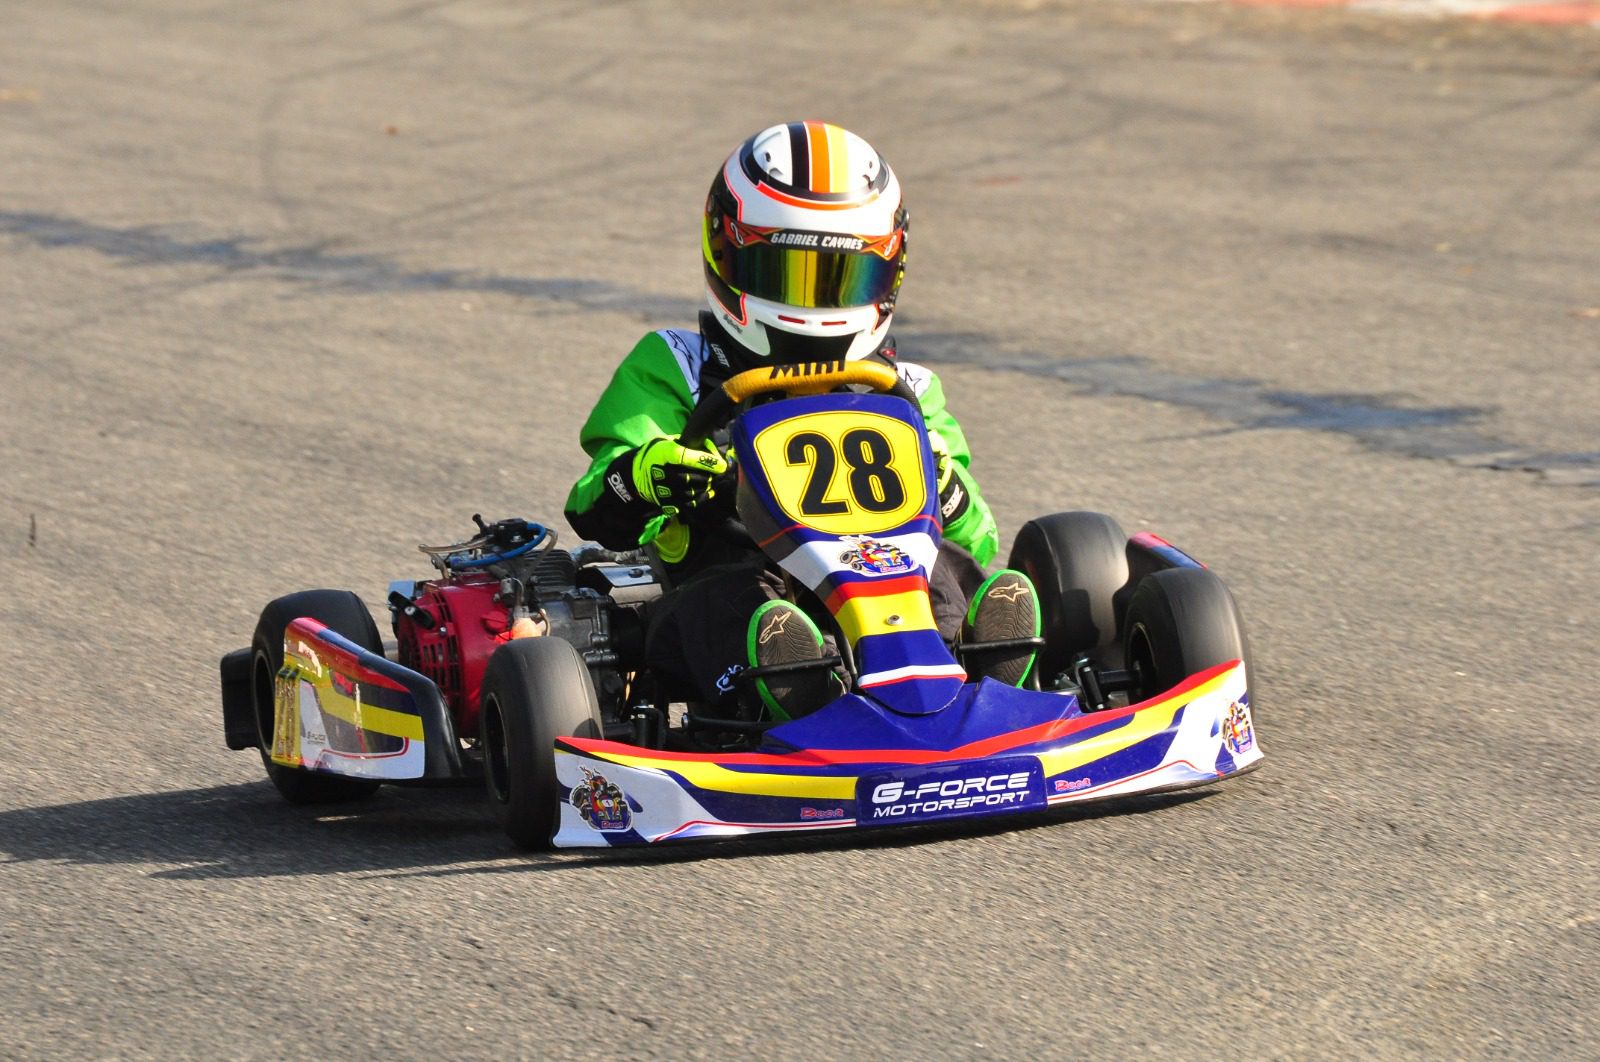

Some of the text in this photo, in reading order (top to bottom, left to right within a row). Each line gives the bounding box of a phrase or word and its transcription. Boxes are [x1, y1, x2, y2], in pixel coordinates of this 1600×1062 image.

[770, 232, 818, 247] GABRIEL
[608, 472, 632, 502] OMP
[785, 427, 908, 518] 28
[871, 772, 1031, 804] G-FORCE
[873, 790, 1031, 819] MOTORSPORT
